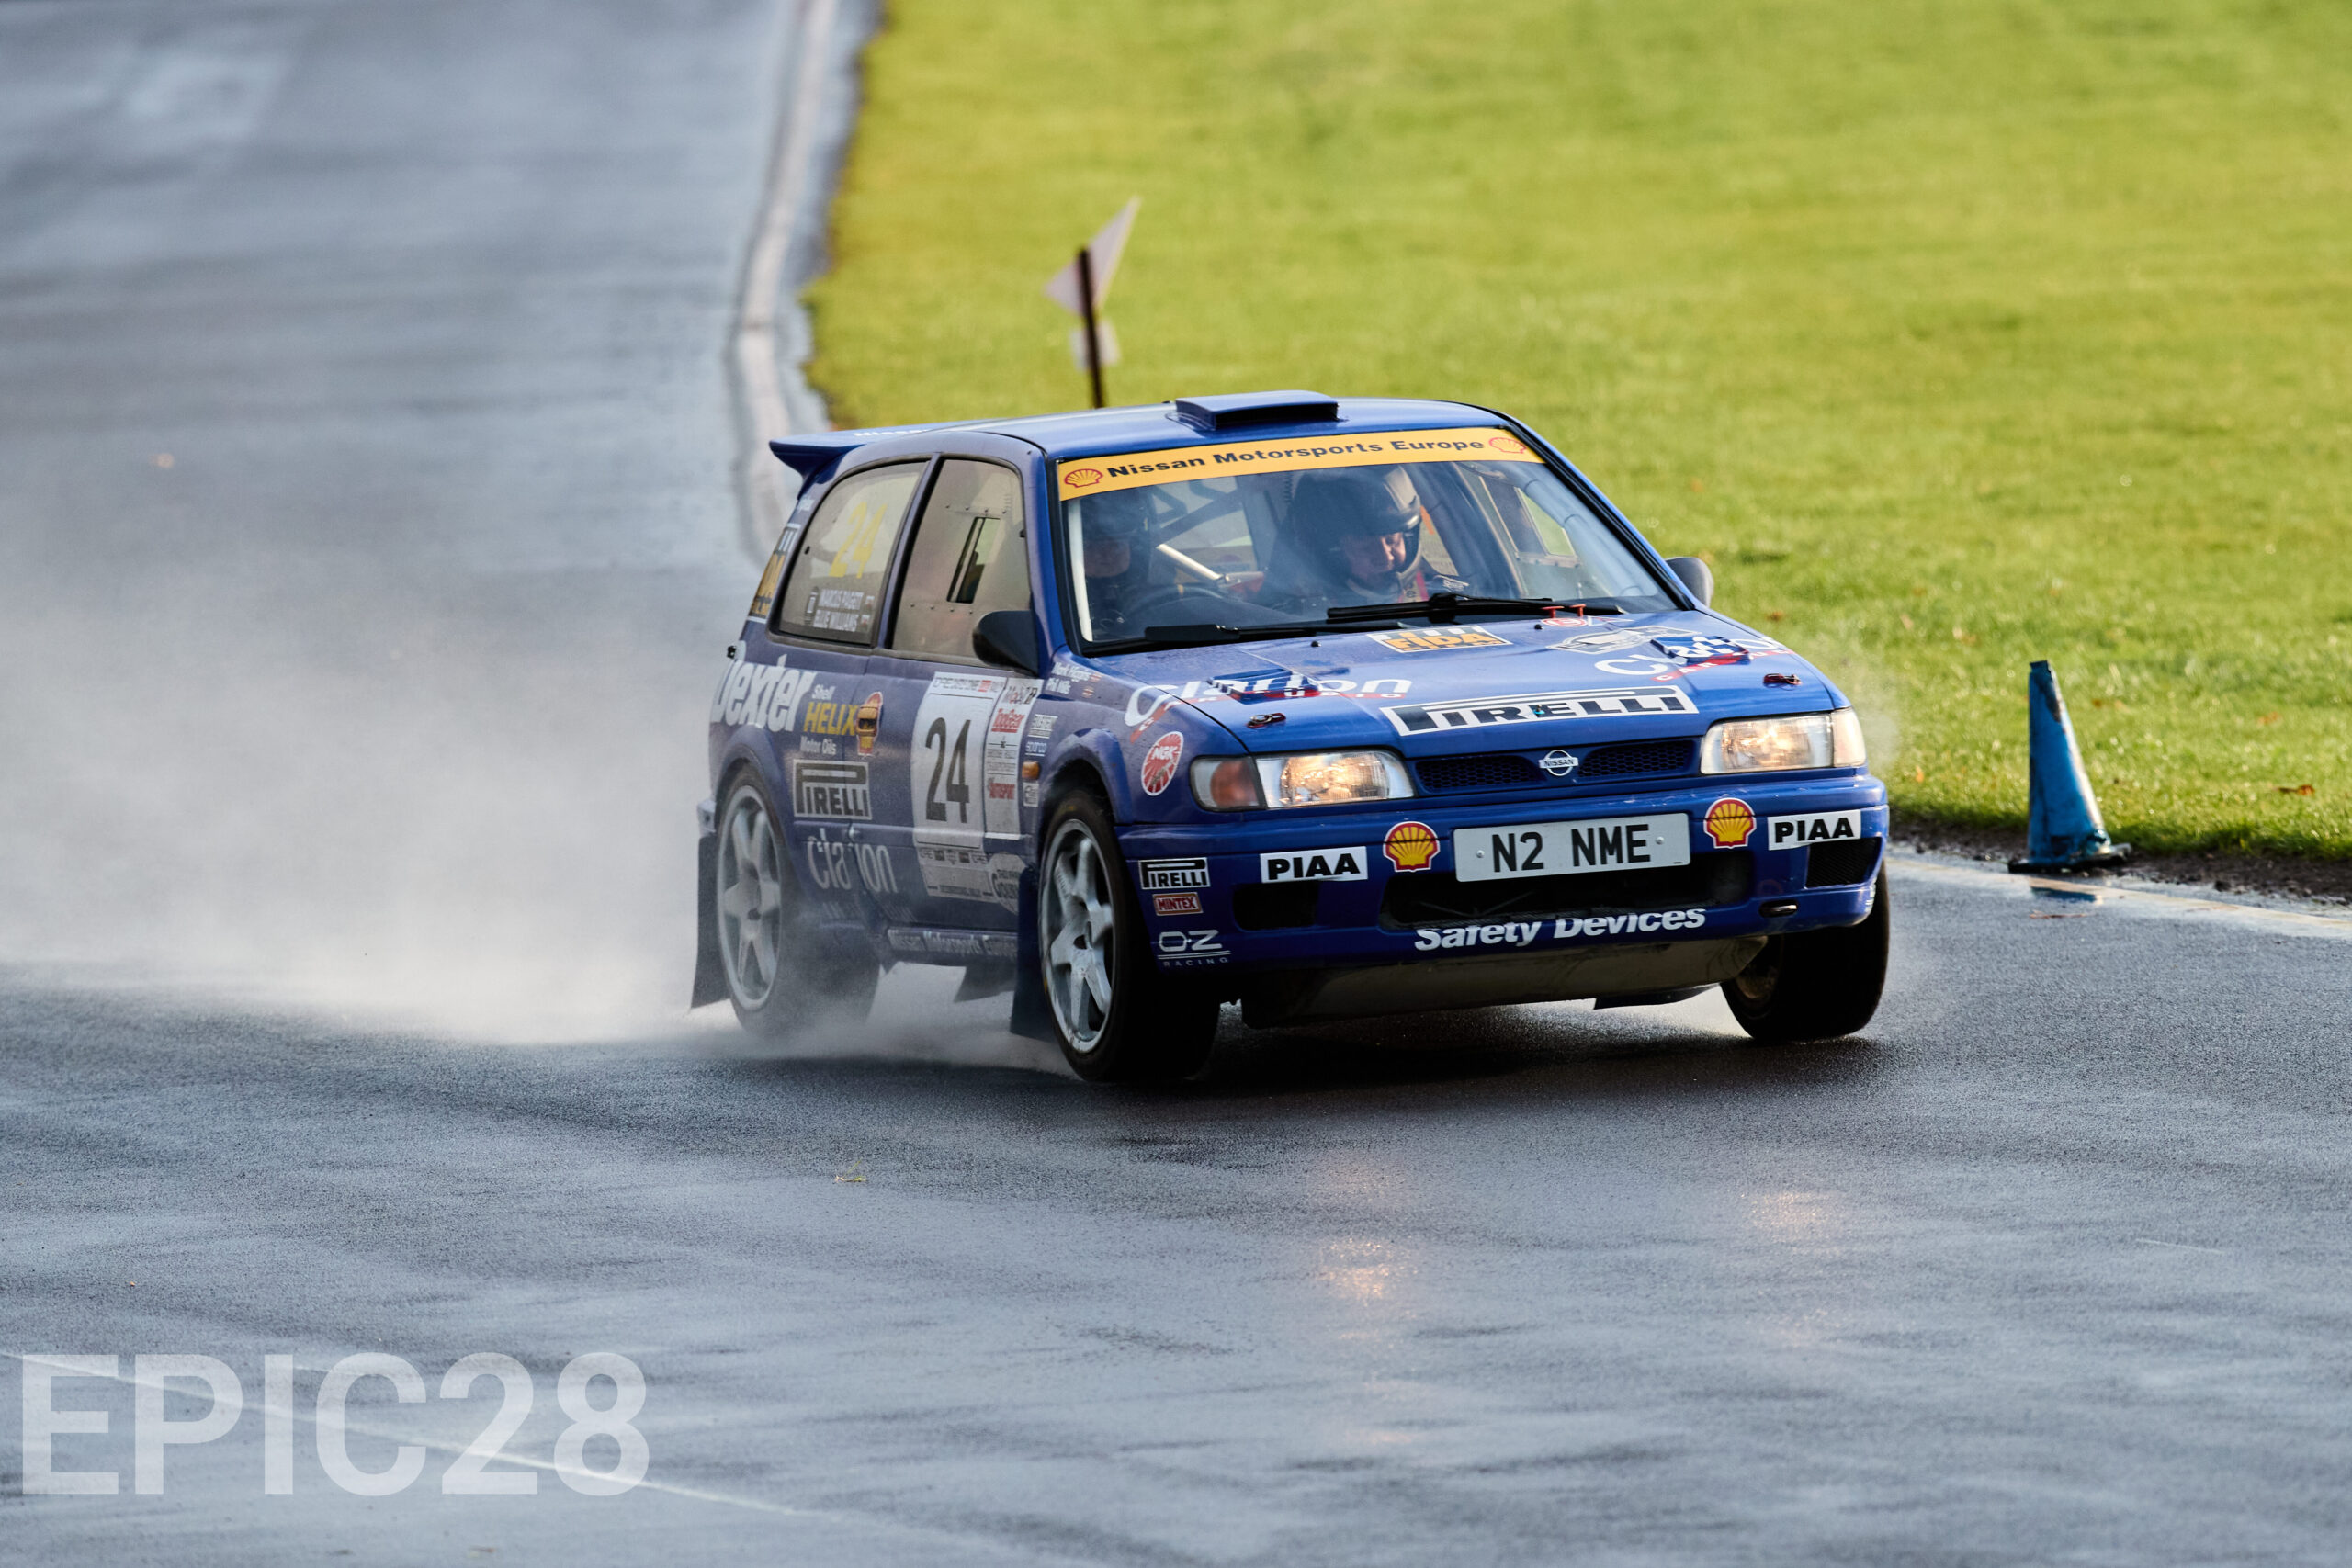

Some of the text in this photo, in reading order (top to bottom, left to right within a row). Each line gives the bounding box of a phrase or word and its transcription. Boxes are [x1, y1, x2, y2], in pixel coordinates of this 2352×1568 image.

[1106, 440, 1484, 478] Nissan Motorsports Europe
[829, 501, 888, 580] 24
[803, 702, 858, 736] HELIX
[1393, 685, 1685, 732] PIRELLI
[926, 716, 971, 824] 24
[1151, 745, 1179, 761] NGK
[1544, 759, 1574, 767] NISSAN
[796, 762, 869, 817] PIRELLI
[1773, 816, 1856, 843] PIAA
[1491, 824, 1651, 873] N2 NME
[1140, 859, 1207, 888] PIRELLI
[1267, 852, 1361, 880] PIAA
[1157, 897, 1197, 912] MINTEX
[1415, 908, 1707, 952] Safety Devices
[1163, 956, 1229, 968] RACING
